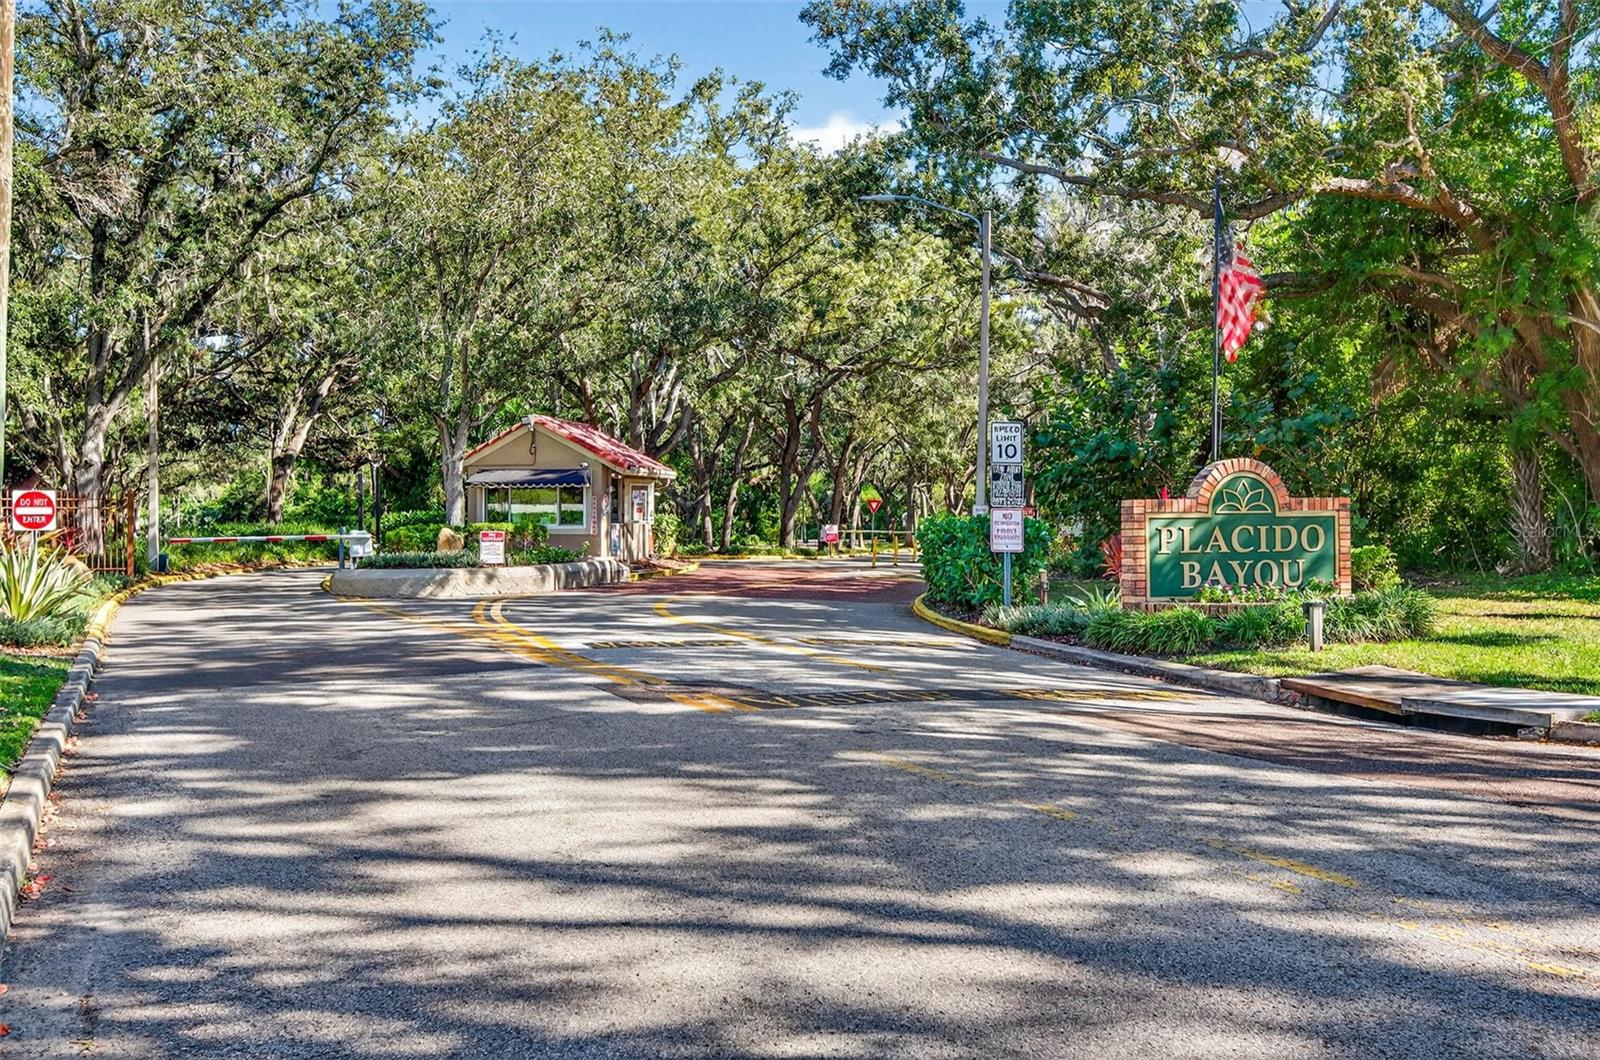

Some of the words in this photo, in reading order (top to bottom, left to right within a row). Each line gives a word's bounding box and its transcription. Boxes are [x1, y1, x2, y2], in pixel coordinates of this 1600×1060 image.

[994, 425, 1020, 433] SPEED
[997, 443, 1017, 458] 10
[20, 498, 31, 506] DO
[33, 498, 48, 506] NOT
[1156, 524, 1326, 554] PLACIDO
[1180, 559, 1306, 589] BAYOU
